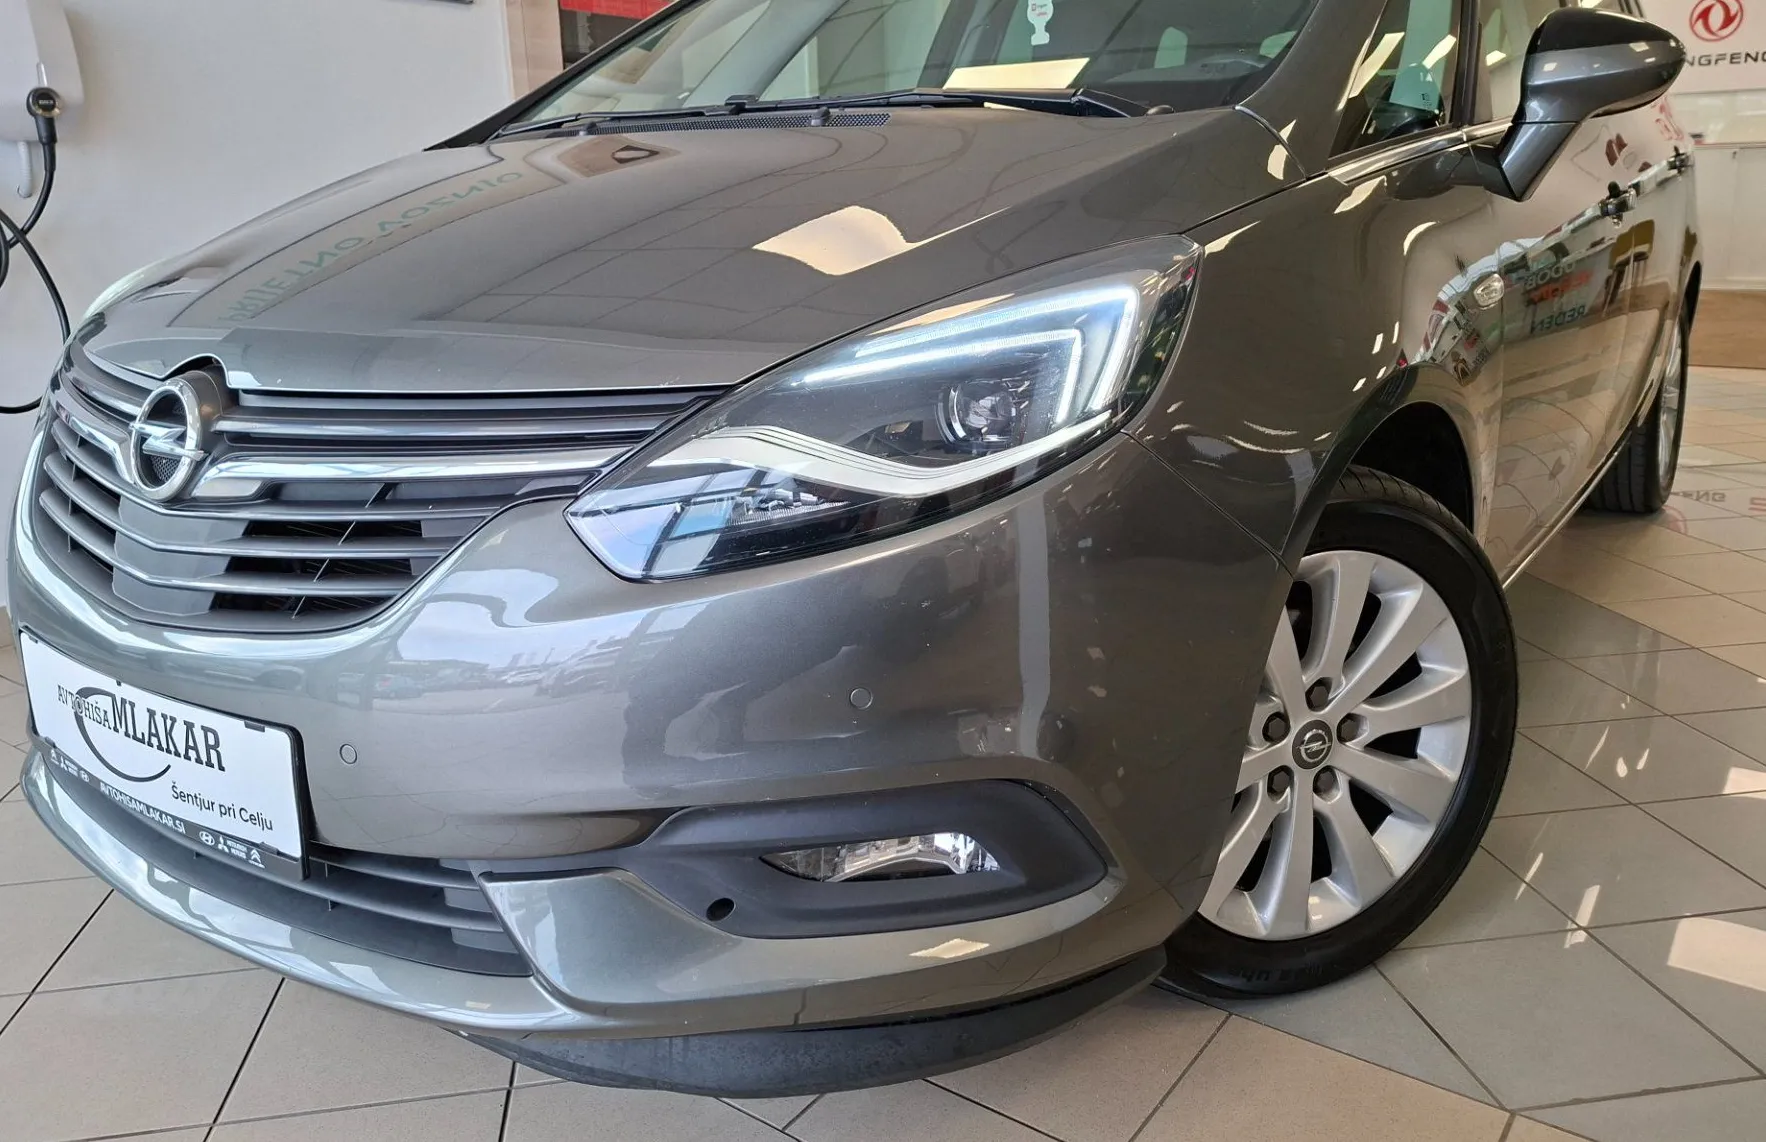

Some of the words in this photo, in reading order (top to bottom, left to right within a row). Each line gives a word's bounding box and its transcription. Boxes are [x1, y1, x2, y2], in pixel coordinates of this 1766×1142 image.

[57, 684, 112, 730] AVTOHIŠA
[111, 693, 226, 772] MLAKAR
[171, 780, 215, 811] Šentjur
[218, 803, 237, 819] pri
[239, 807, 273, 831] Celju
